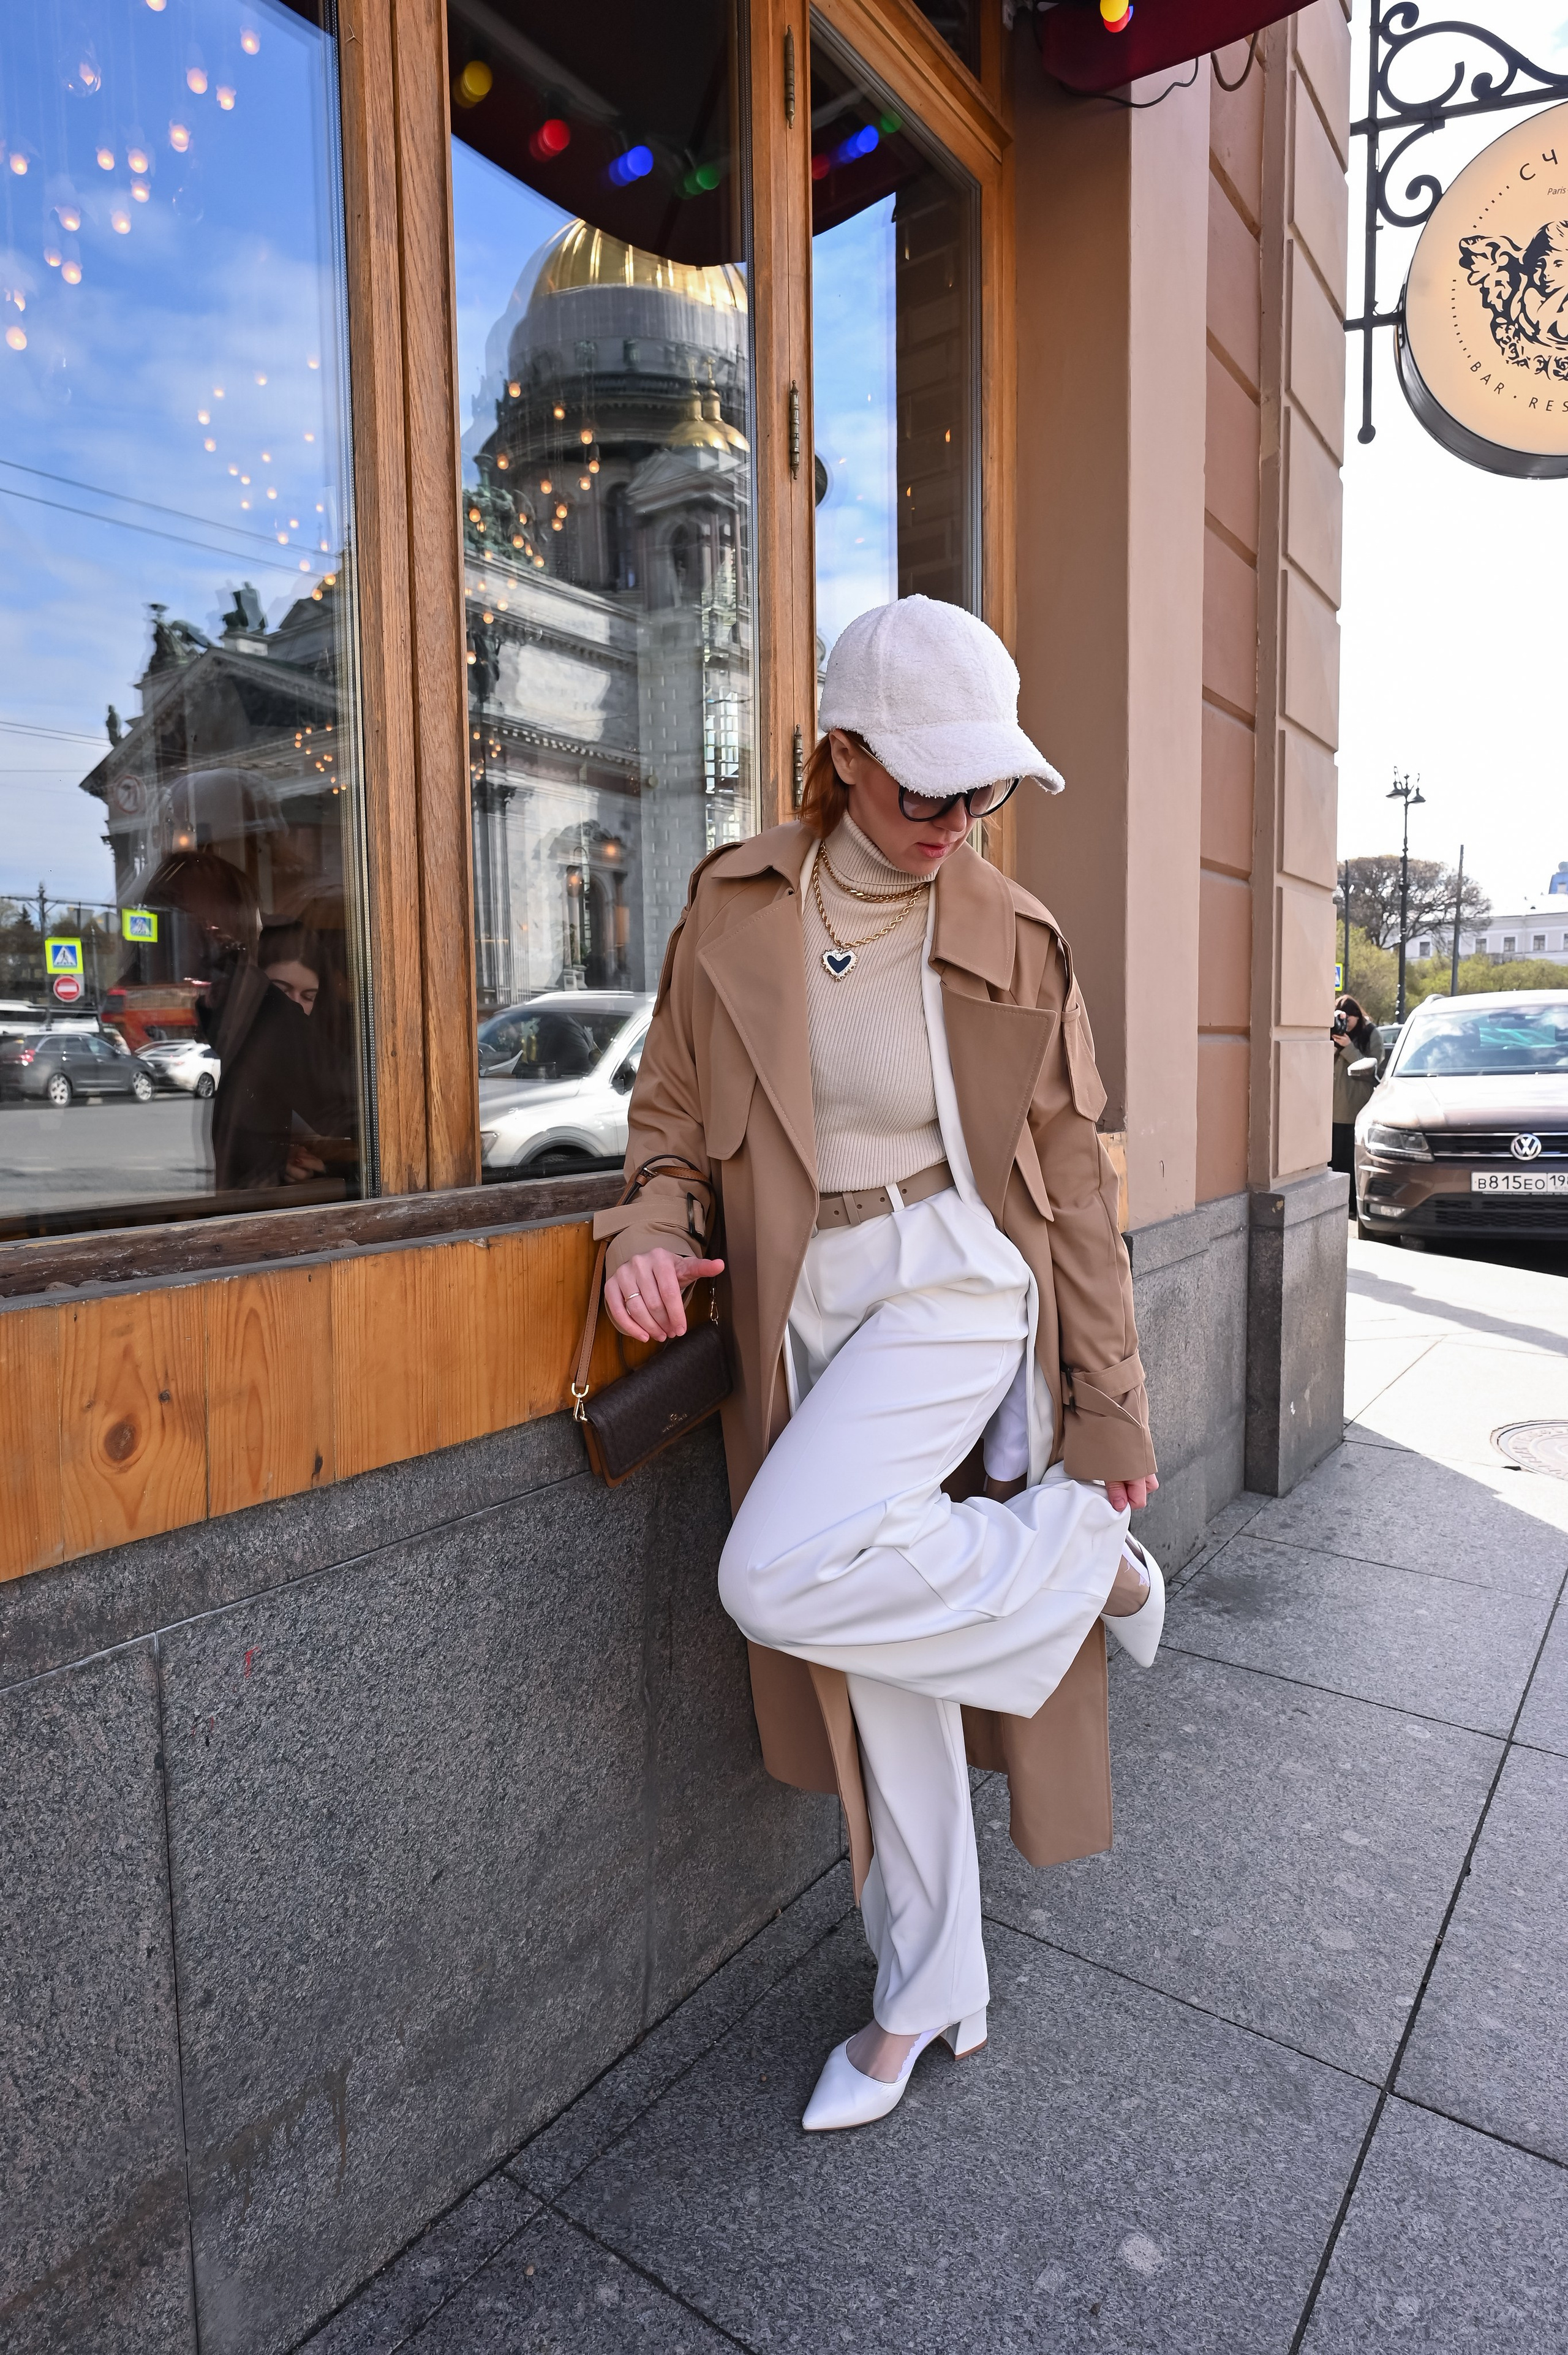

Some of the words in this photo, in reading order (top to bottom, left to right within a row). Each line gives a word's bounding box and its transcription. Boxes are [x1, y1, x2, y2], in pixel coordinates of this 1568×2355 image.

[1547, 186, 1567, 195] Paris
[1470, 361, 1505, 395] BAR
[1549, 1174, 1568, 1186] 19
